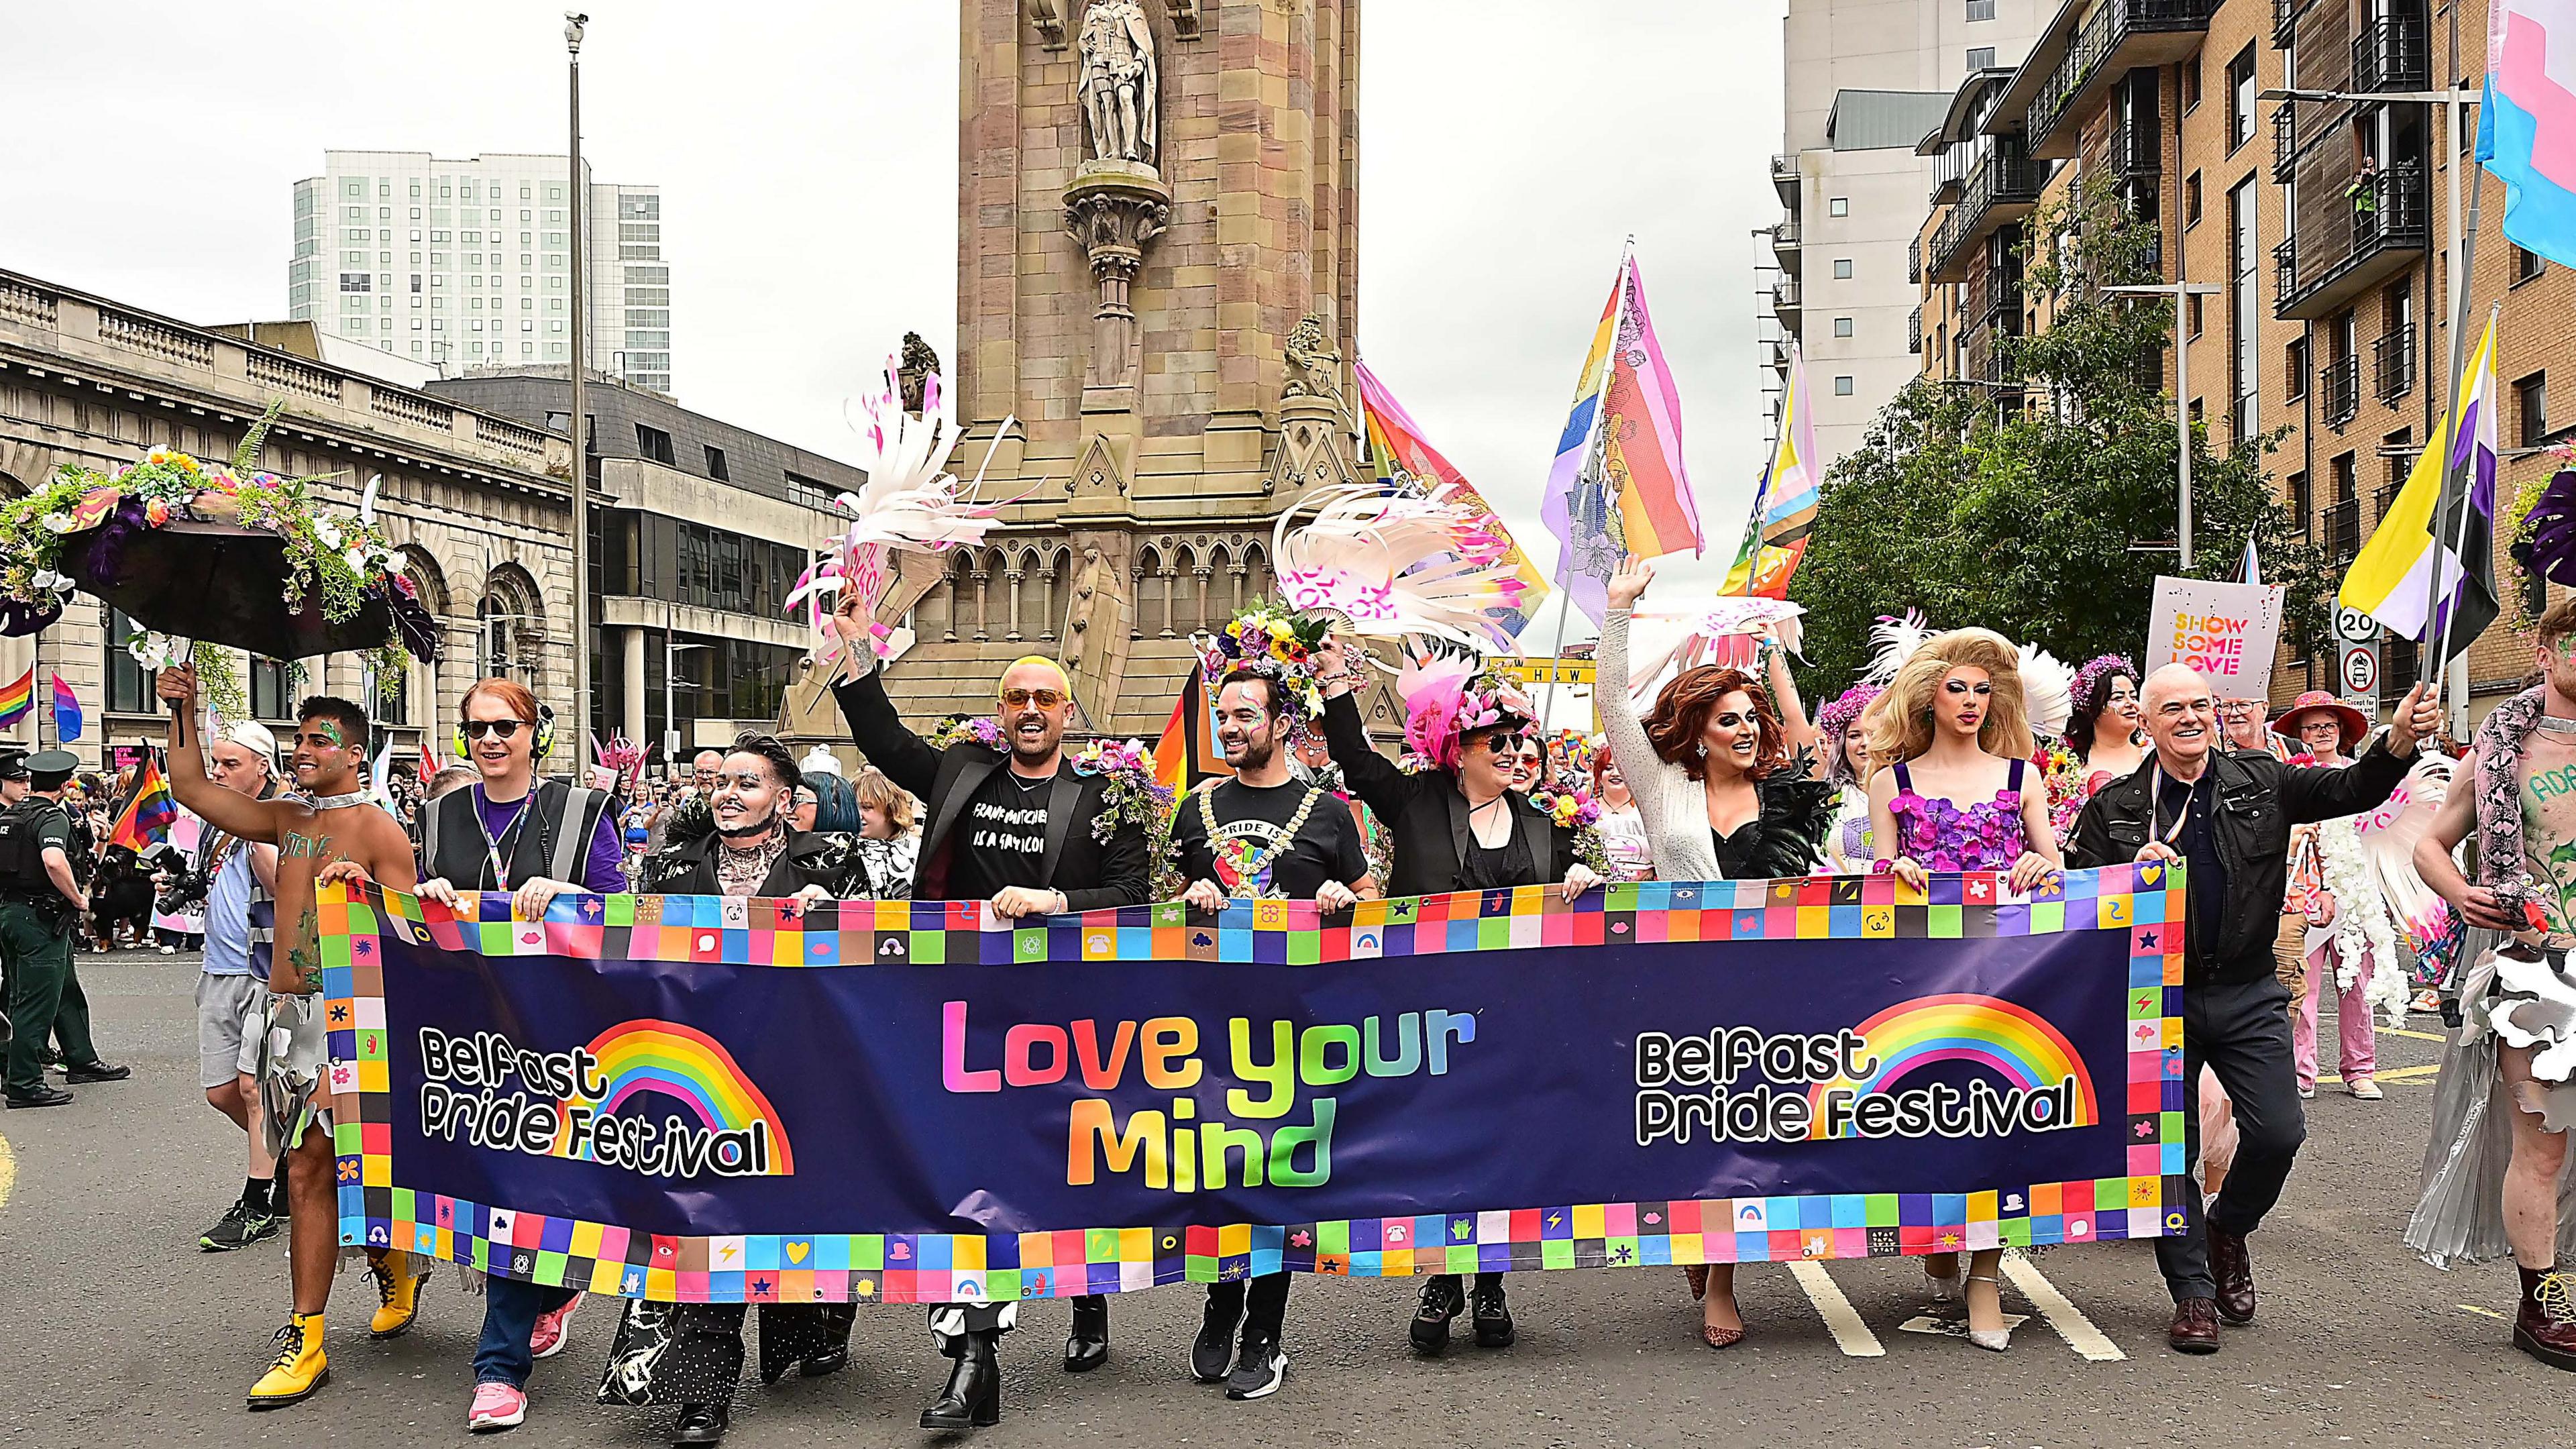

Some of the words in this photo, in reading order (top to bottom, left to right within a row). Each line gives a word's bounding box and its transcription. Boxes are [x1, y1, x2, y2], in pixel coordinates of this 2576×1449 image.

[2176, 613, 2248, 634] SHOW
[2343, 614, 2373, 631] 20
[2173, 632, 2243, 655] SOME
[1534, 669, 1542, 680] H
[1570, 670, 1580, 681] W
[972, 803, 1006, 820] FRANK
[44, 837, 64, 845] POLICE
[973, 830, 987, 846] IS
[986, 833, 996, 847] A
[1000, 833, 1020, 850] GAY
[1219, 823, 1263, 839] PRIDE
[1267, 828, 1282, 839] IS
[280, 832, 333, 859] STEVE
[419, 1026, 610, 1102] Belfast
[943, 1001, 1202, 1093] Love
[1226, 1009, 1476, 1118] your
[1635, 1026, 1880, 1087] Belfast
[1635, 1083, 1811, 1146] Pride
[1824, 1073, 2078, 1140] Festival
[420, 1082, 561, 1156] Pride
[566, 1104, 769, 1178] Festival
[1067, 1097, 1336, 1193] Mind
